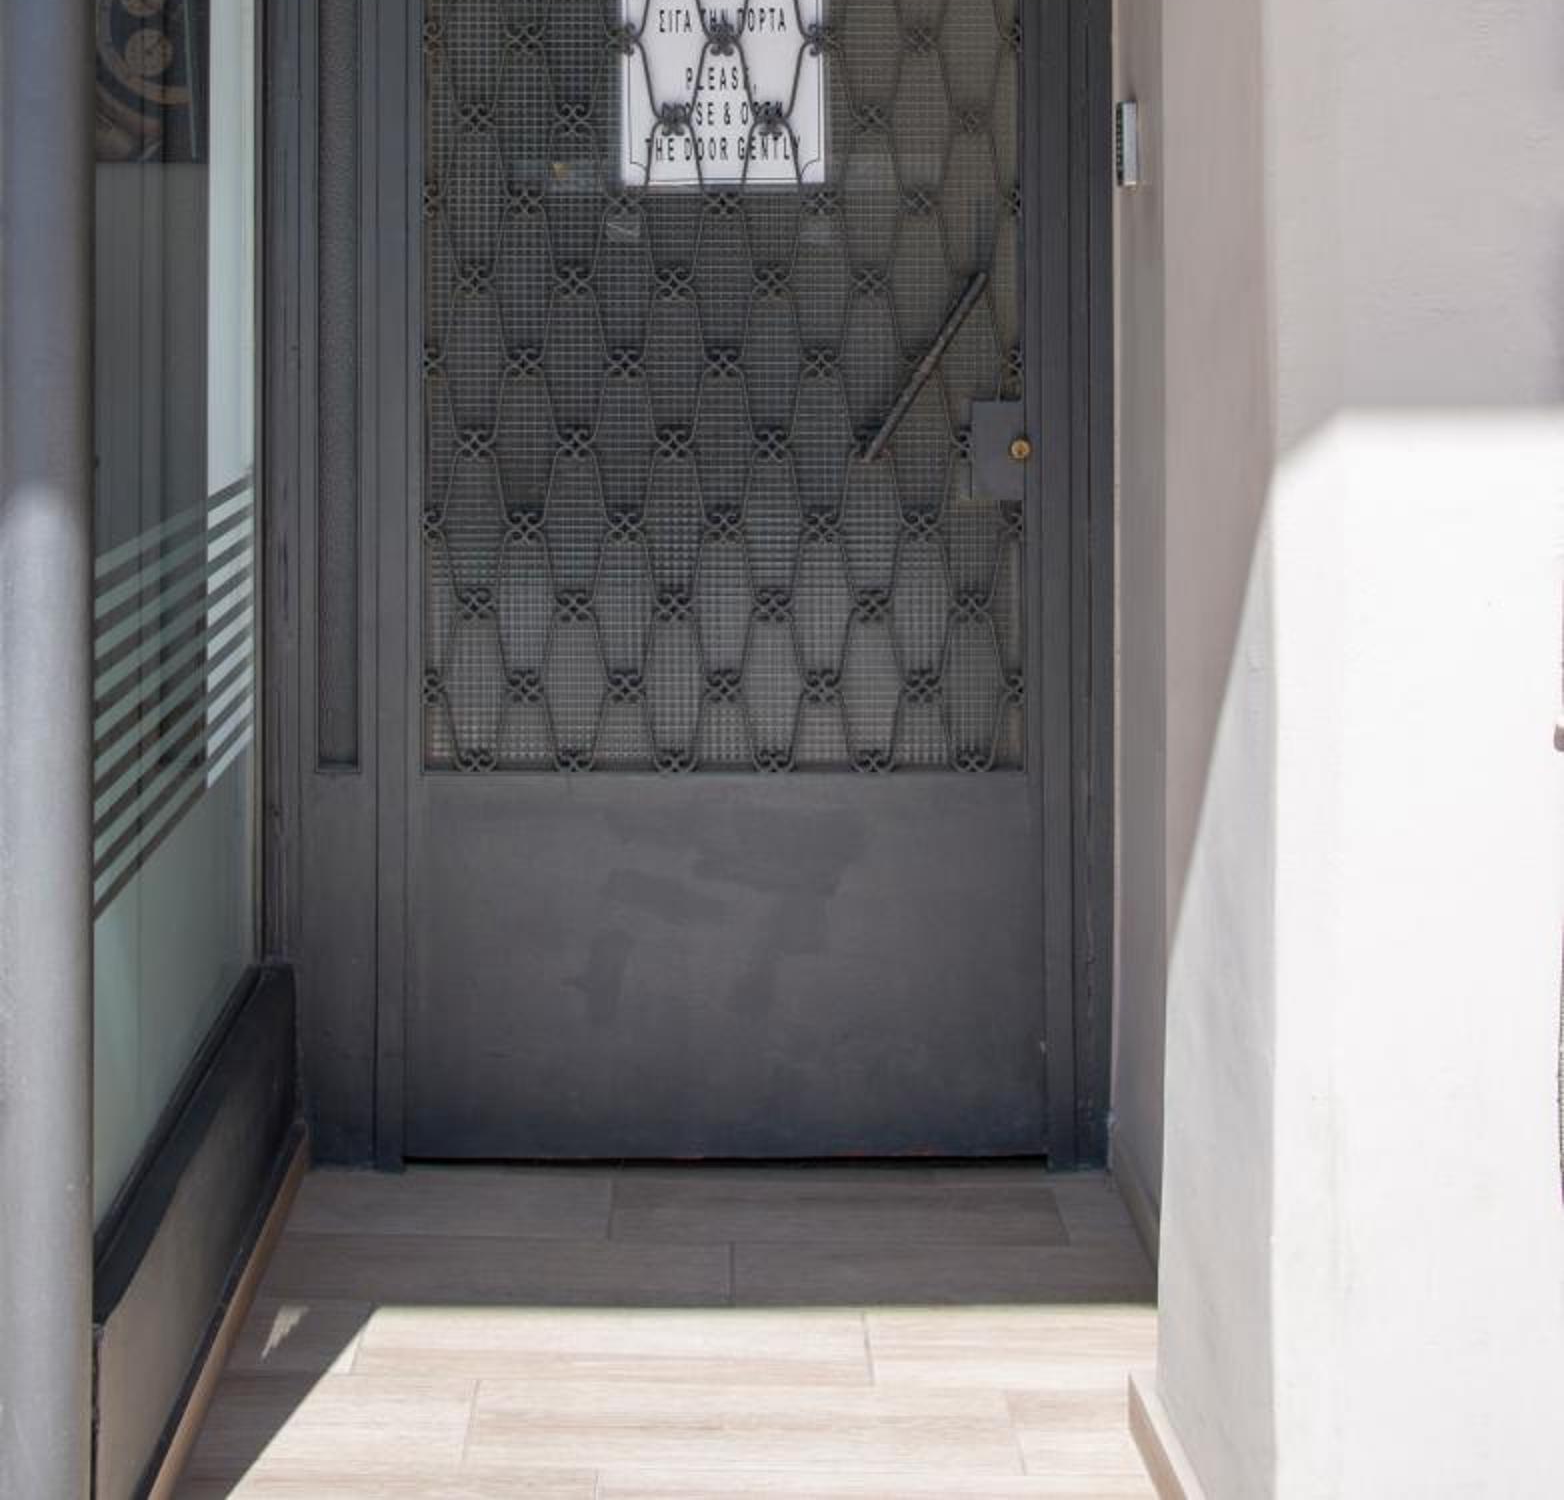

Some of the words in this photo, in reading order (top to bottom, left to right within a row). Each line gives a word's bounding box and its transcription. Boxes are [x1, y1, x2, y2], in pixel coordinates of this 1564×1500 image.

[685, 66, 757, 94] PLEAS,
[723, 101, 731, 125] &
[645, 137, 675, 161] THE
[684, 136, 729, 161] DOOR
